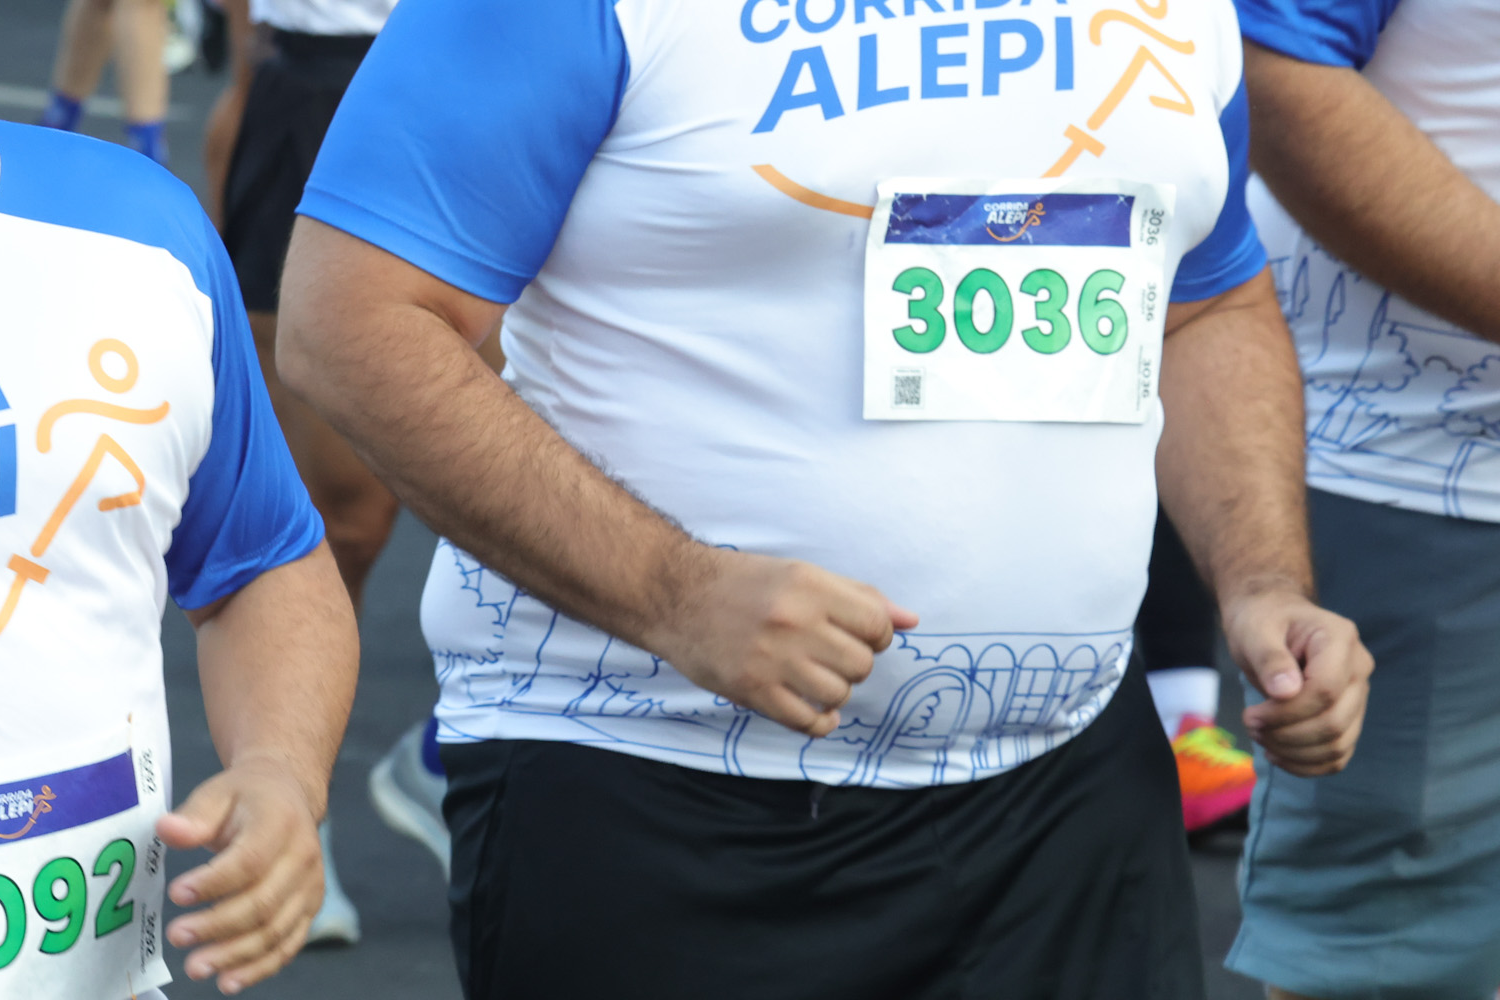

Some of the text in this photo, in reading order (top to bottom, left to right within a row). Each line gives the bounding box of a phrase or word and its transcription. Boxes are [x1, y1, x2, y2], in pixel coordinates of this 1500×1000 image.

[750, 16, 1075, 134] ALEPI
[983, 202, 1030, 213] CORRIDA
[986, 210, 1027, 225] ALEPI
[1146, 208, 1165, 246] 3036
[892, 266, 1129, 355] 3036
